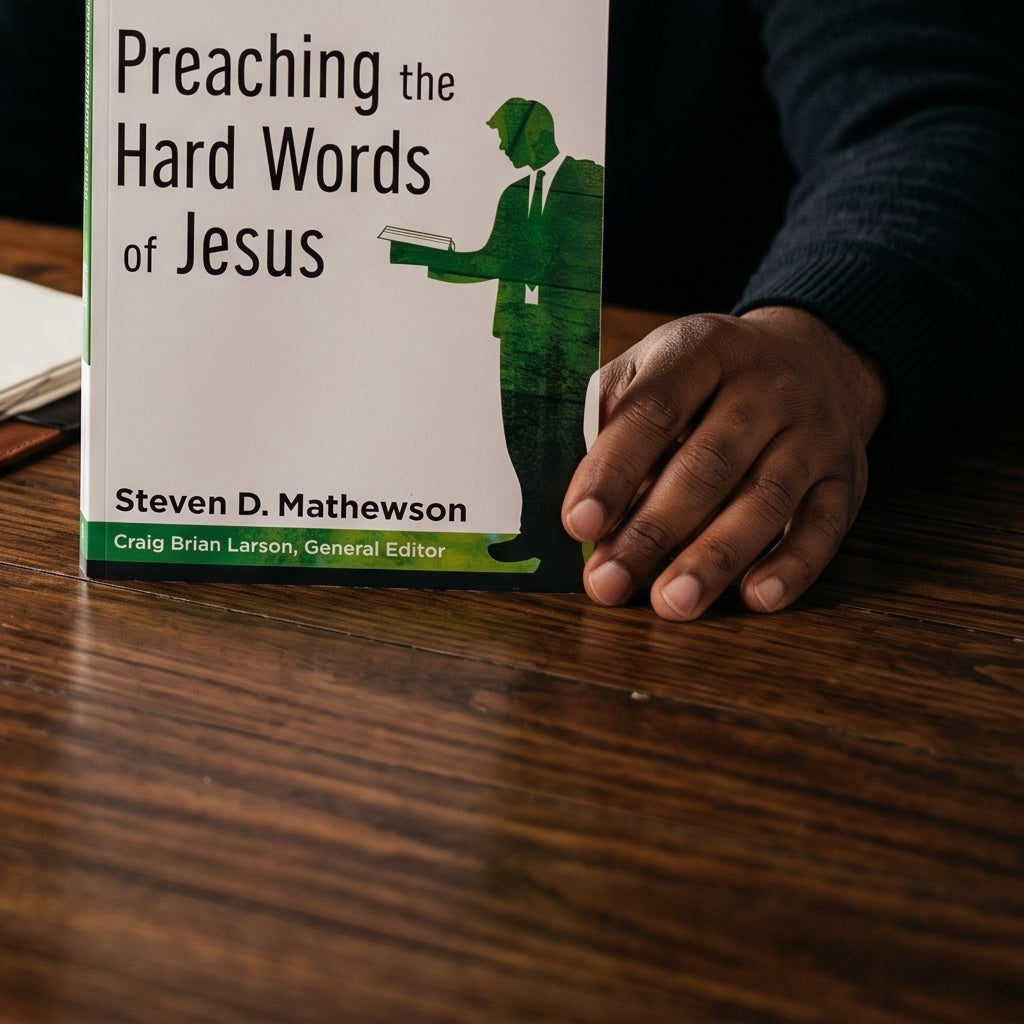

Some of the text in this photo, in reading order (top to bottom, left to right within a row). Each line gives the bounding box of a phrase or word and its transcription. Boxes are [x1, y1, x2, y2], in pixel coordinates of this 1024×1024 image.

[117, 29, 455, 117] Preaching the
[117, 122, 431, 196] Hard Words
[123, 211, 325, 279] of Jesus
[114, 487, 467, 523] Steven D. Mathewson
[113, 533, 446, 559] Craig Brian Larson, General Editor
